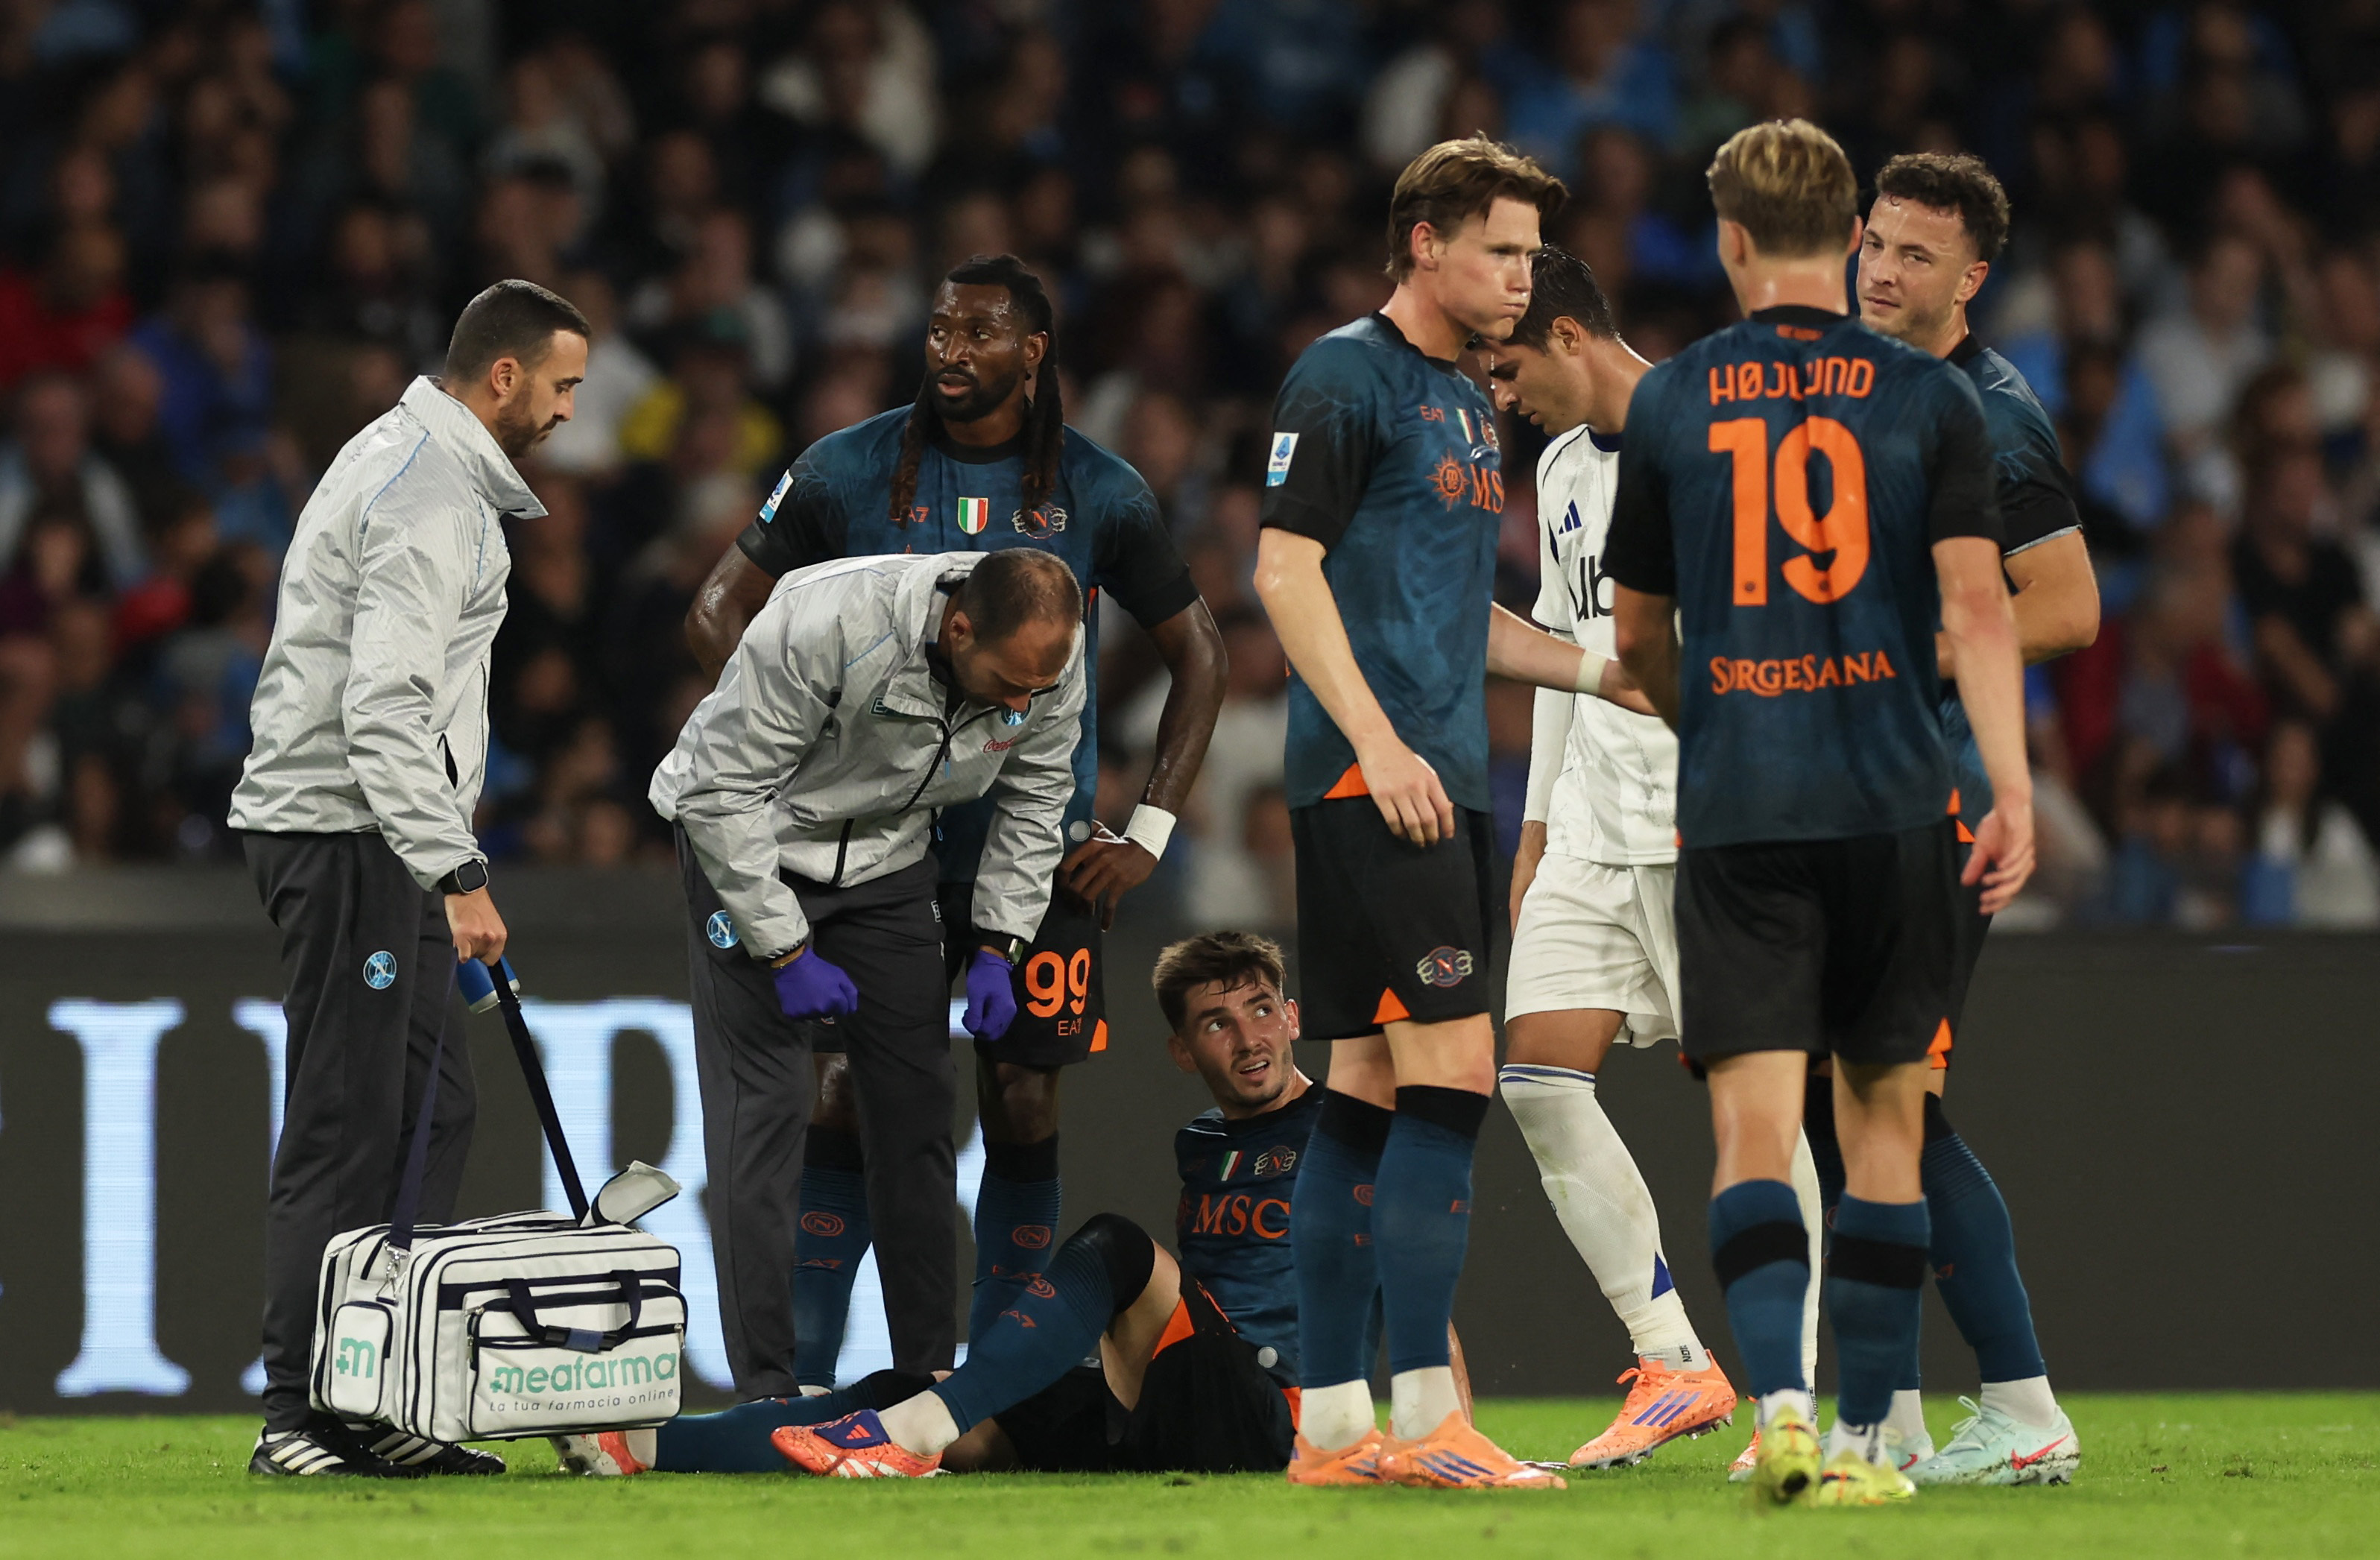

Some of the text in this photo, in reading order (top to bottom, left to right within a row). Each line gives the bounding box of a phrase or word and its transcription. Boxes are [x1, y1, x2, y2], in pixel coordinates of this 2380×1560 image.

[1469, 463, 1505, 514] MS
[1708, 414, 1871, 607] 19
[1710, 644, 1896, 698] SRGESANA
[1026, 947, 1090, 1018] 99
[1192, 1193, 1290, 1239] MSC
[490, 1353, 677, 1395] meafarma
[490, 1388, 674, 1412] La tua farmacia online
